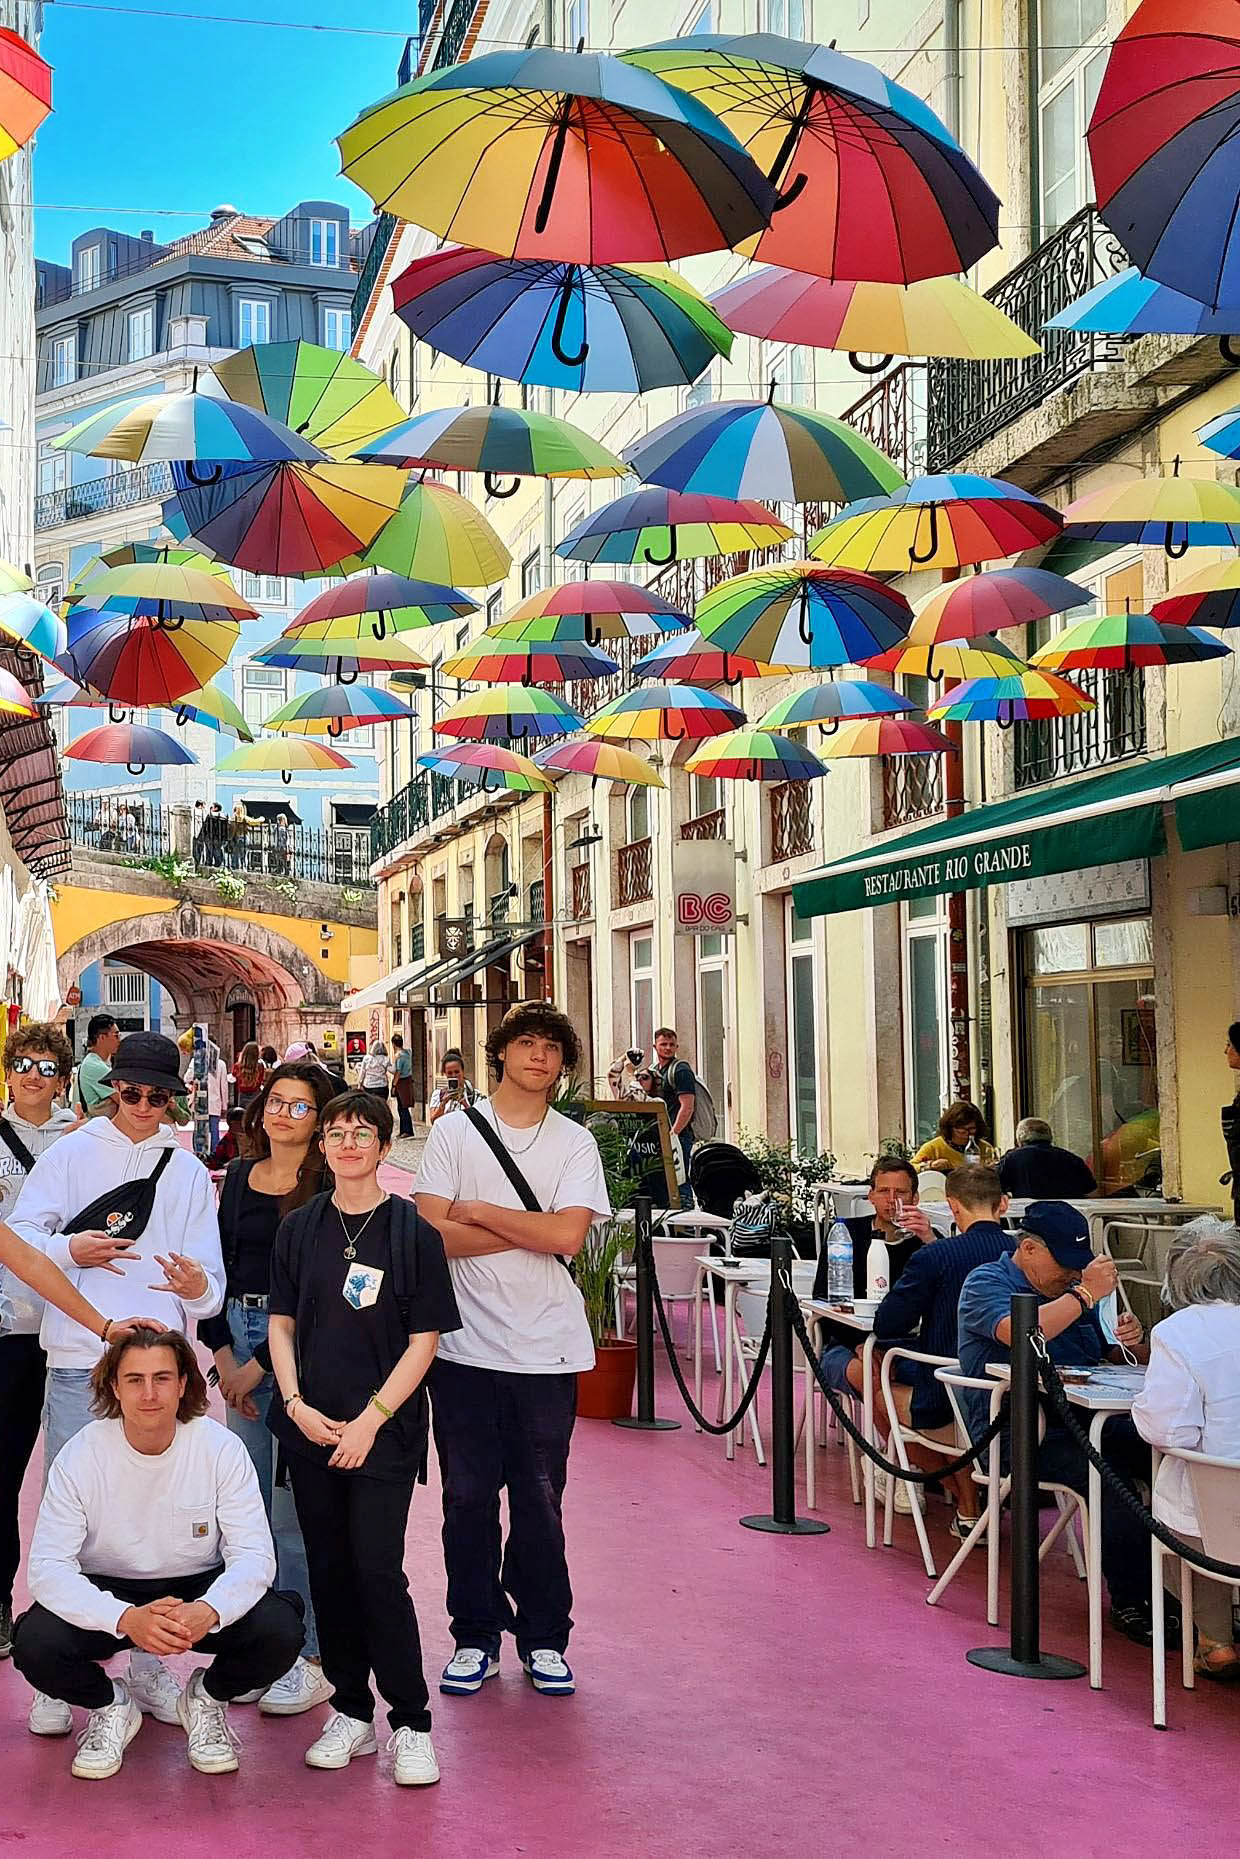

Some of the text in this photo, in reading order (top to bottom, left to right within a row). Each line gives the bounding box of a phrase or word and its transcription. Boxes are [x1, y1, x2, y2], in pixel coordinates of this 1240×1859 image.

[864, 844, 1032, 897] RESTAURANTE RIO GRANDE
[678, 892, 732, 925] BC
